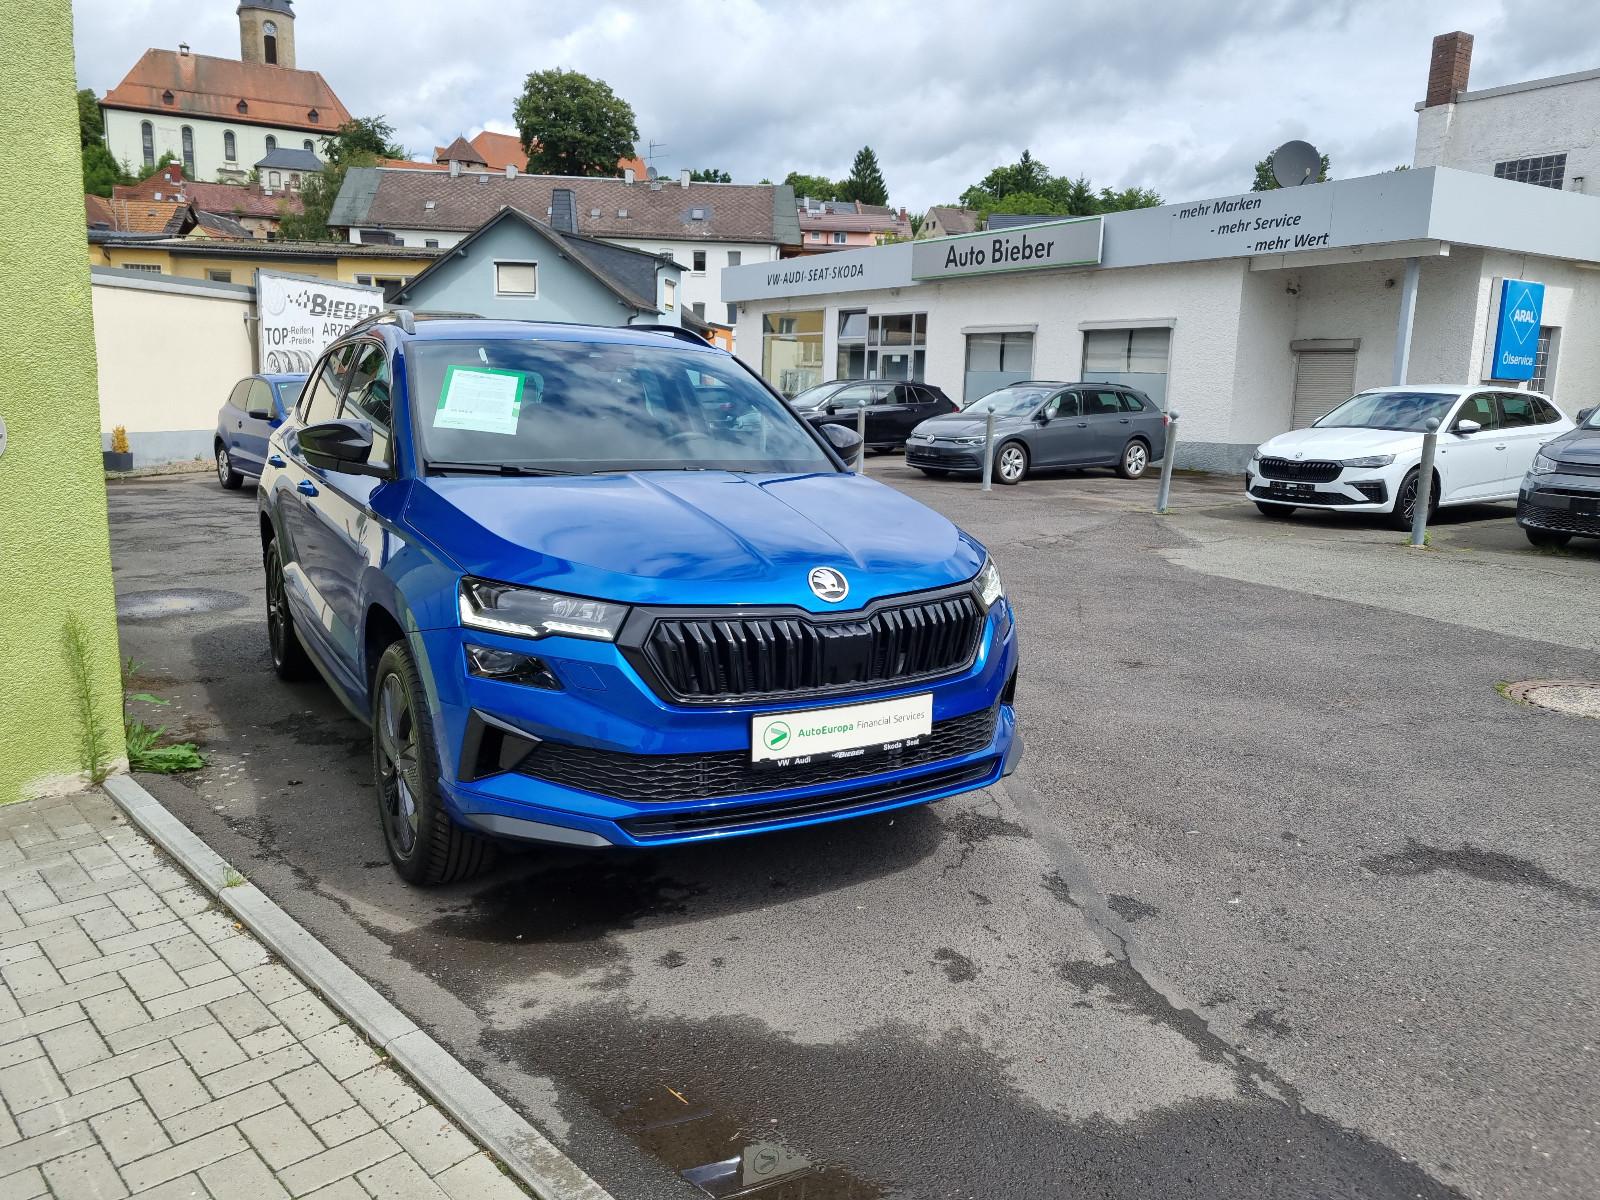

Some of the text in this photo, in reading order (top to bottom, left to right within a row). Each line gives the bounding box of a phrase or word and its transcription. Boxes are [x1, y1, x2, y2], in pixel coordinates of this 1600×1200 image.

[1179, 204, 1211, 220] mehr
[1212, 197, 1262, 215] Marken
[1217, 219, 1252, 235] mehr
[1253, 213, 1302, 231] Service
[944, 234, 1055, 269] Auto Bieber
[1254, 234, 1291, 252] mehr
[1294, 232, 1329, 248] Wert
[1514, 309, 1535, 323] ARAL
[1502, 351, 1534, 366] Ölservice
[798, 711, 925, 738] AutoEuropa Financial Services
[777, 759, 790, 767] VW
[794, 756, 811, 765] Audi
[883, 741, 902, 751] Skoda
[906, 738, 920, 747] Seat
